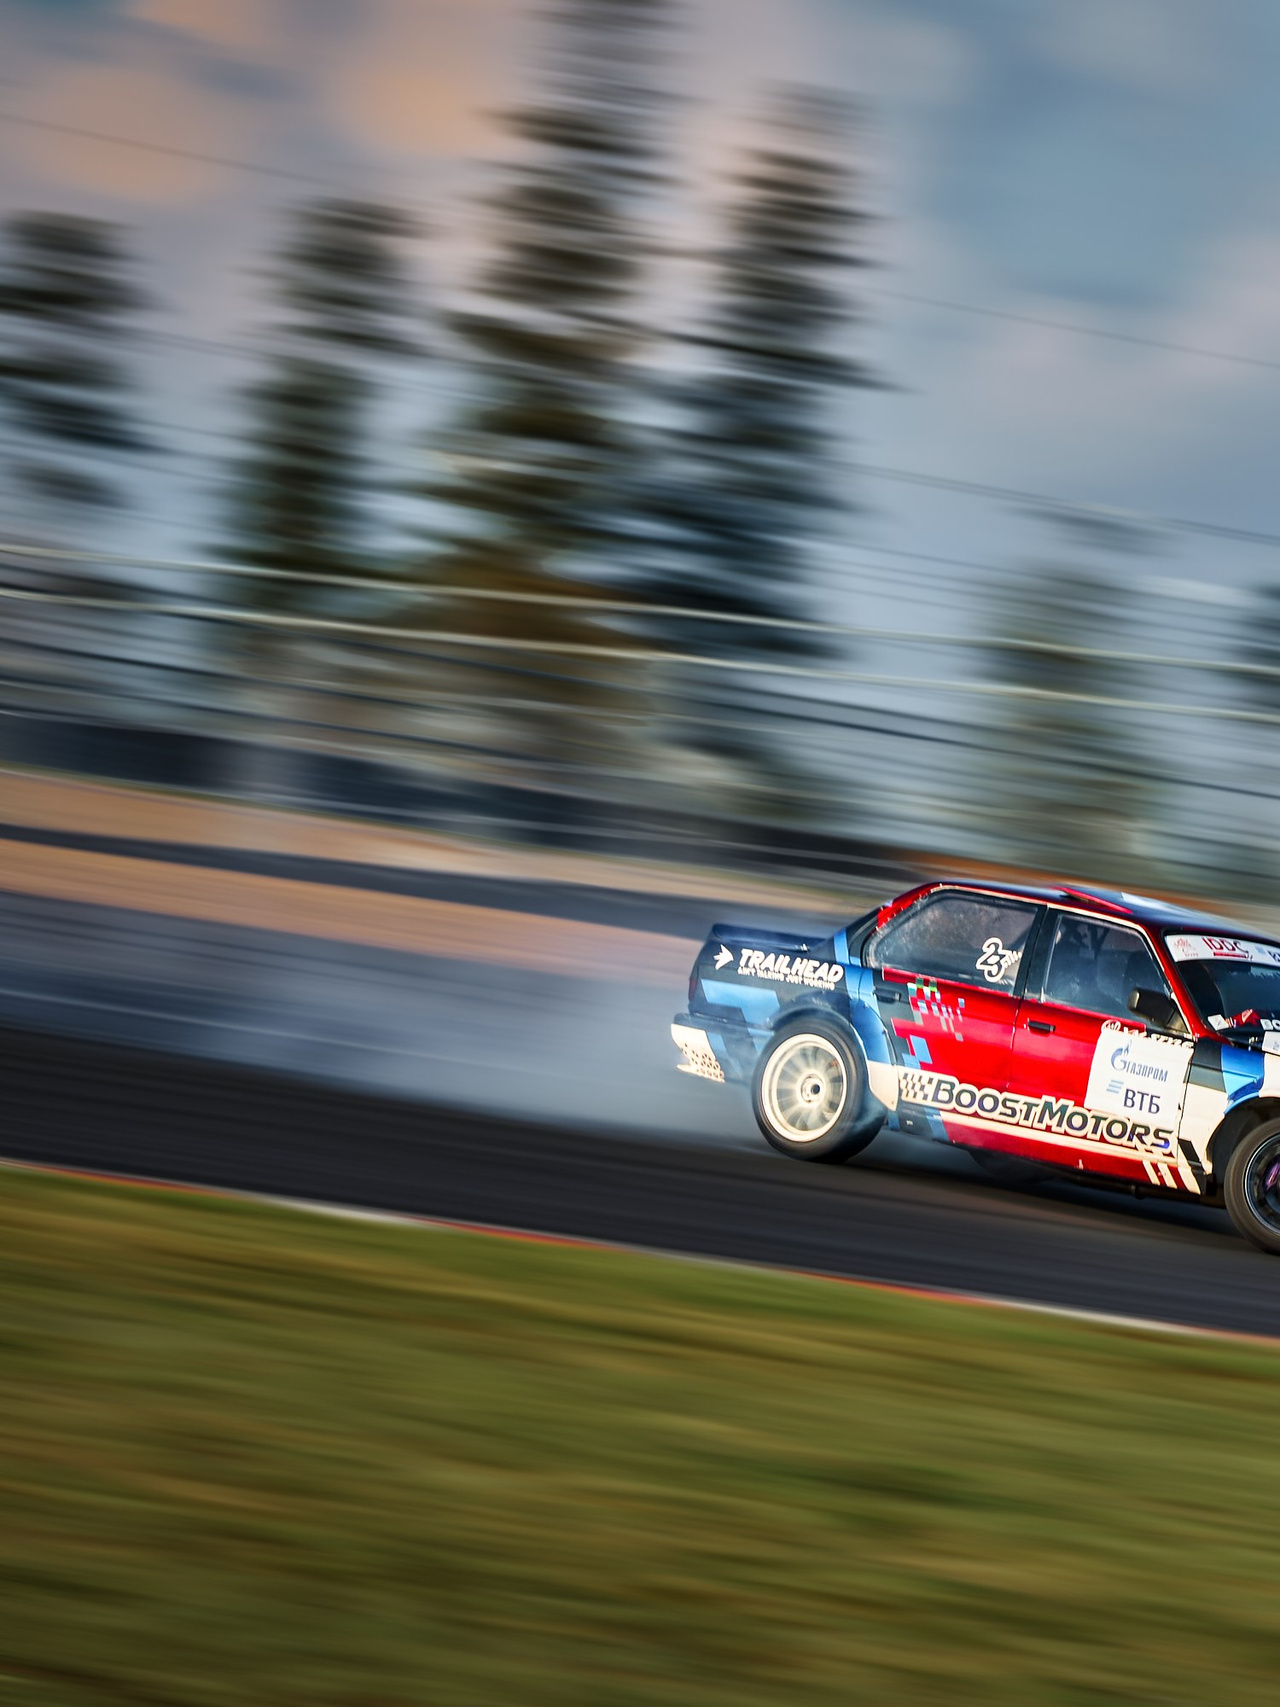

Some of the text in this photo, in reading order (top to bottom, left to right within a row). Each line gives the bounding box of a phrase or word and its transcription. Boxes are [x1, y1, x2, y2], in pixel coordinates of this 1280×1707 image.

[739, 948, 844, 982] TRAILHEAD
[931, 1077, 1175, 1150] BOOSTMOTORS
[1123, 1088, 1161, 1114] ВТБ
